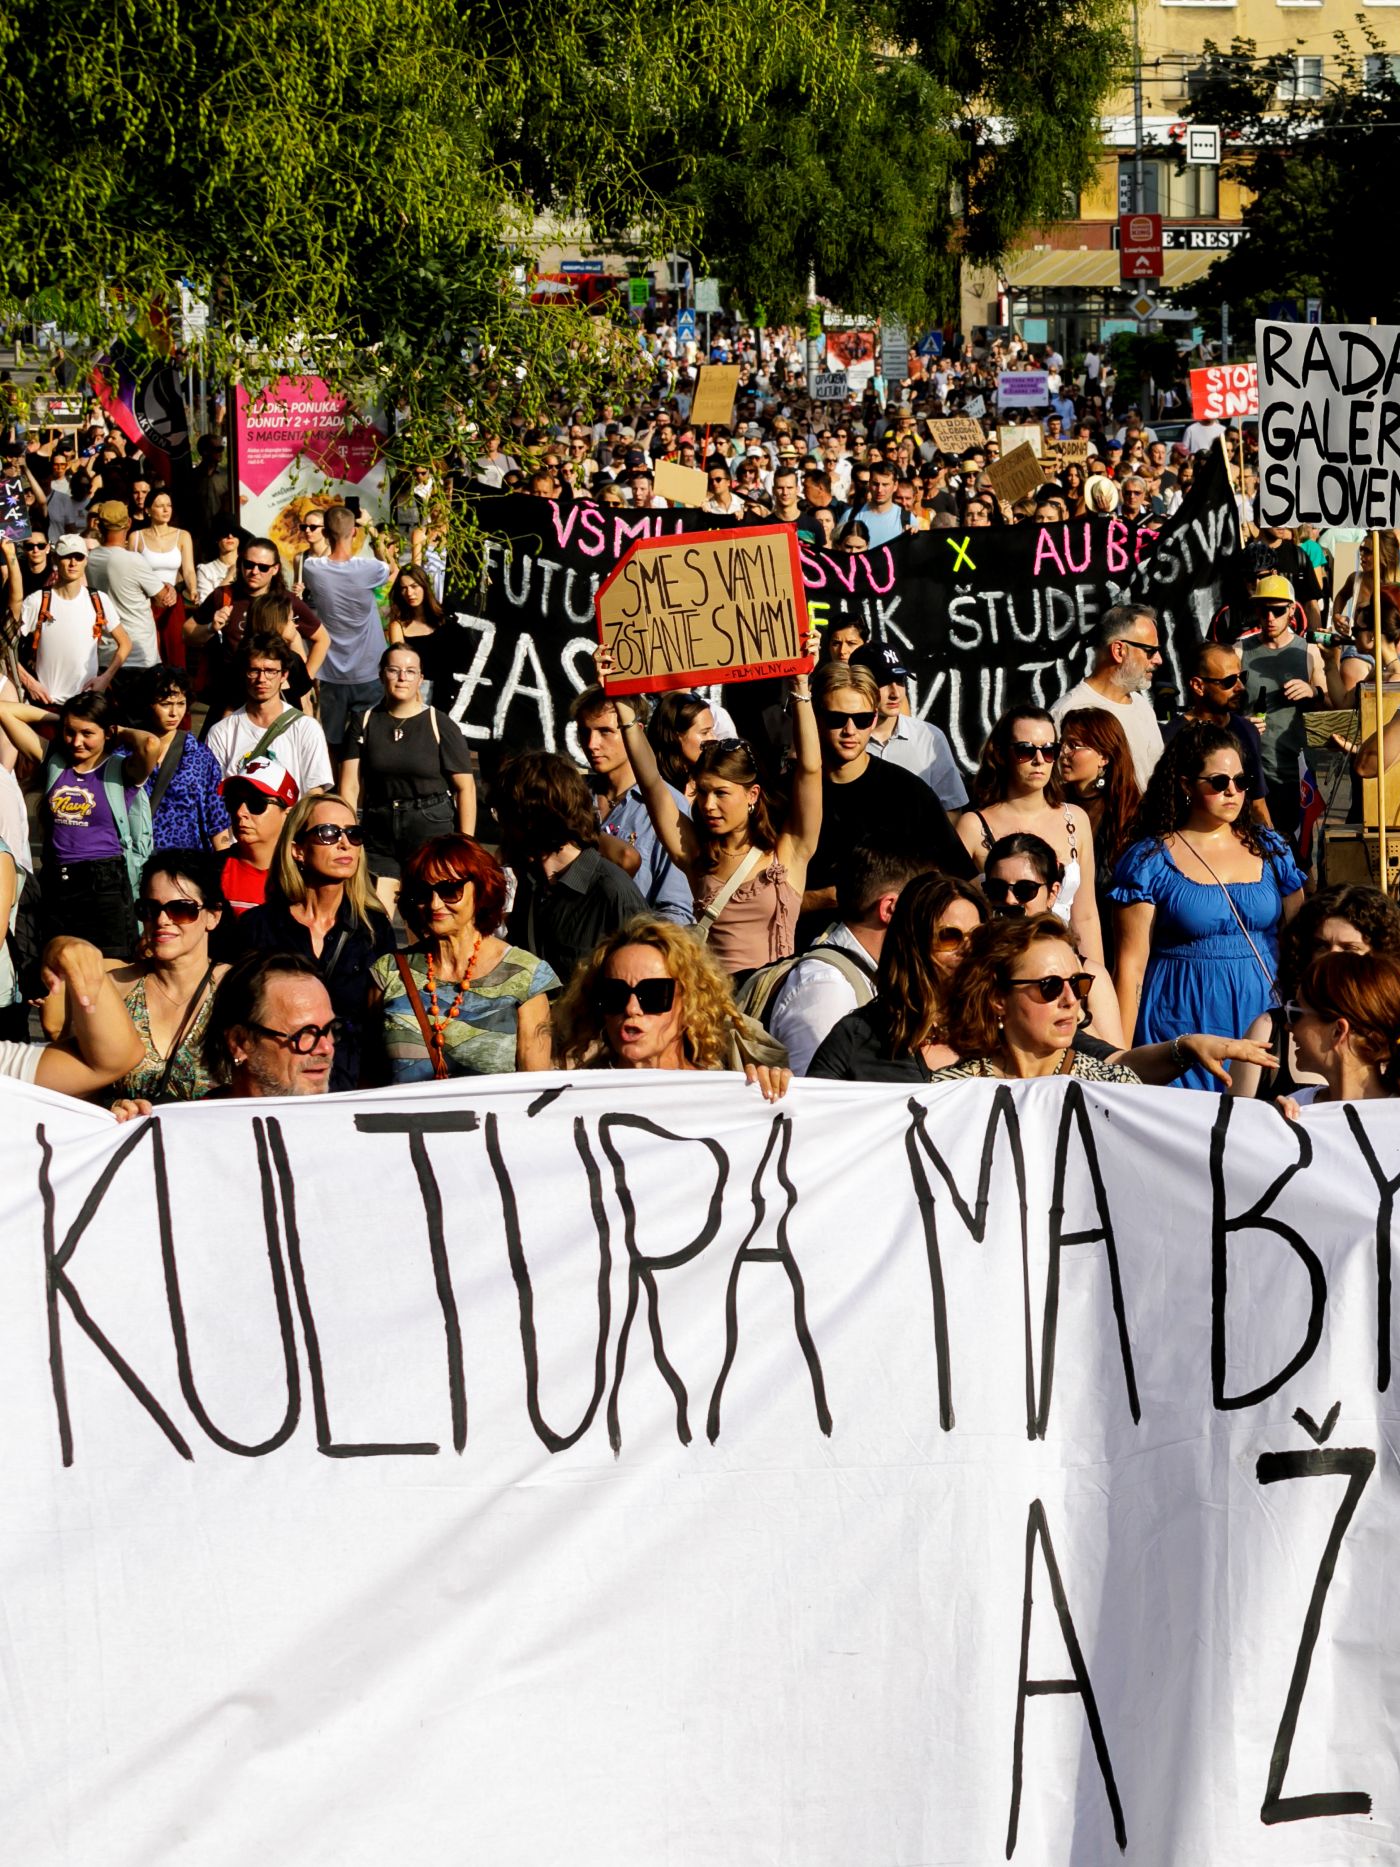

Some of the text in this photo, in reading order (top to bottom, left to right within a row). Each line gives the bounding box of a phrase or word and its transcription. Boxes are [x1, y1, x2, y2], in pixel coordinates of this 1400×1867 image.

[1190, 231, 1251, 247] REST
[246, 415, 292, 428] DONUTY
[293, 415, 301, 427] 2
[290, 401, 340, 414] PONUKA:
[247, 431, 254, 442] S
[255, 430, 308, 442] MAGENTA
[547, 499, 684, 559] VŠM
[946, 536, 977, 573] X
[1033, 521, 1093, 577] AU
[620, 546, 682, 619] SME
[682, 547, 710, 608] S
[711, 602, 737, 667] S
[736, 597, 798, 666] NAMI
[51, 795, 91, 816] Navy
[35, 1084, 834, 1468] KULTÚRA
[1006, 1498, 1129, 1861] A
